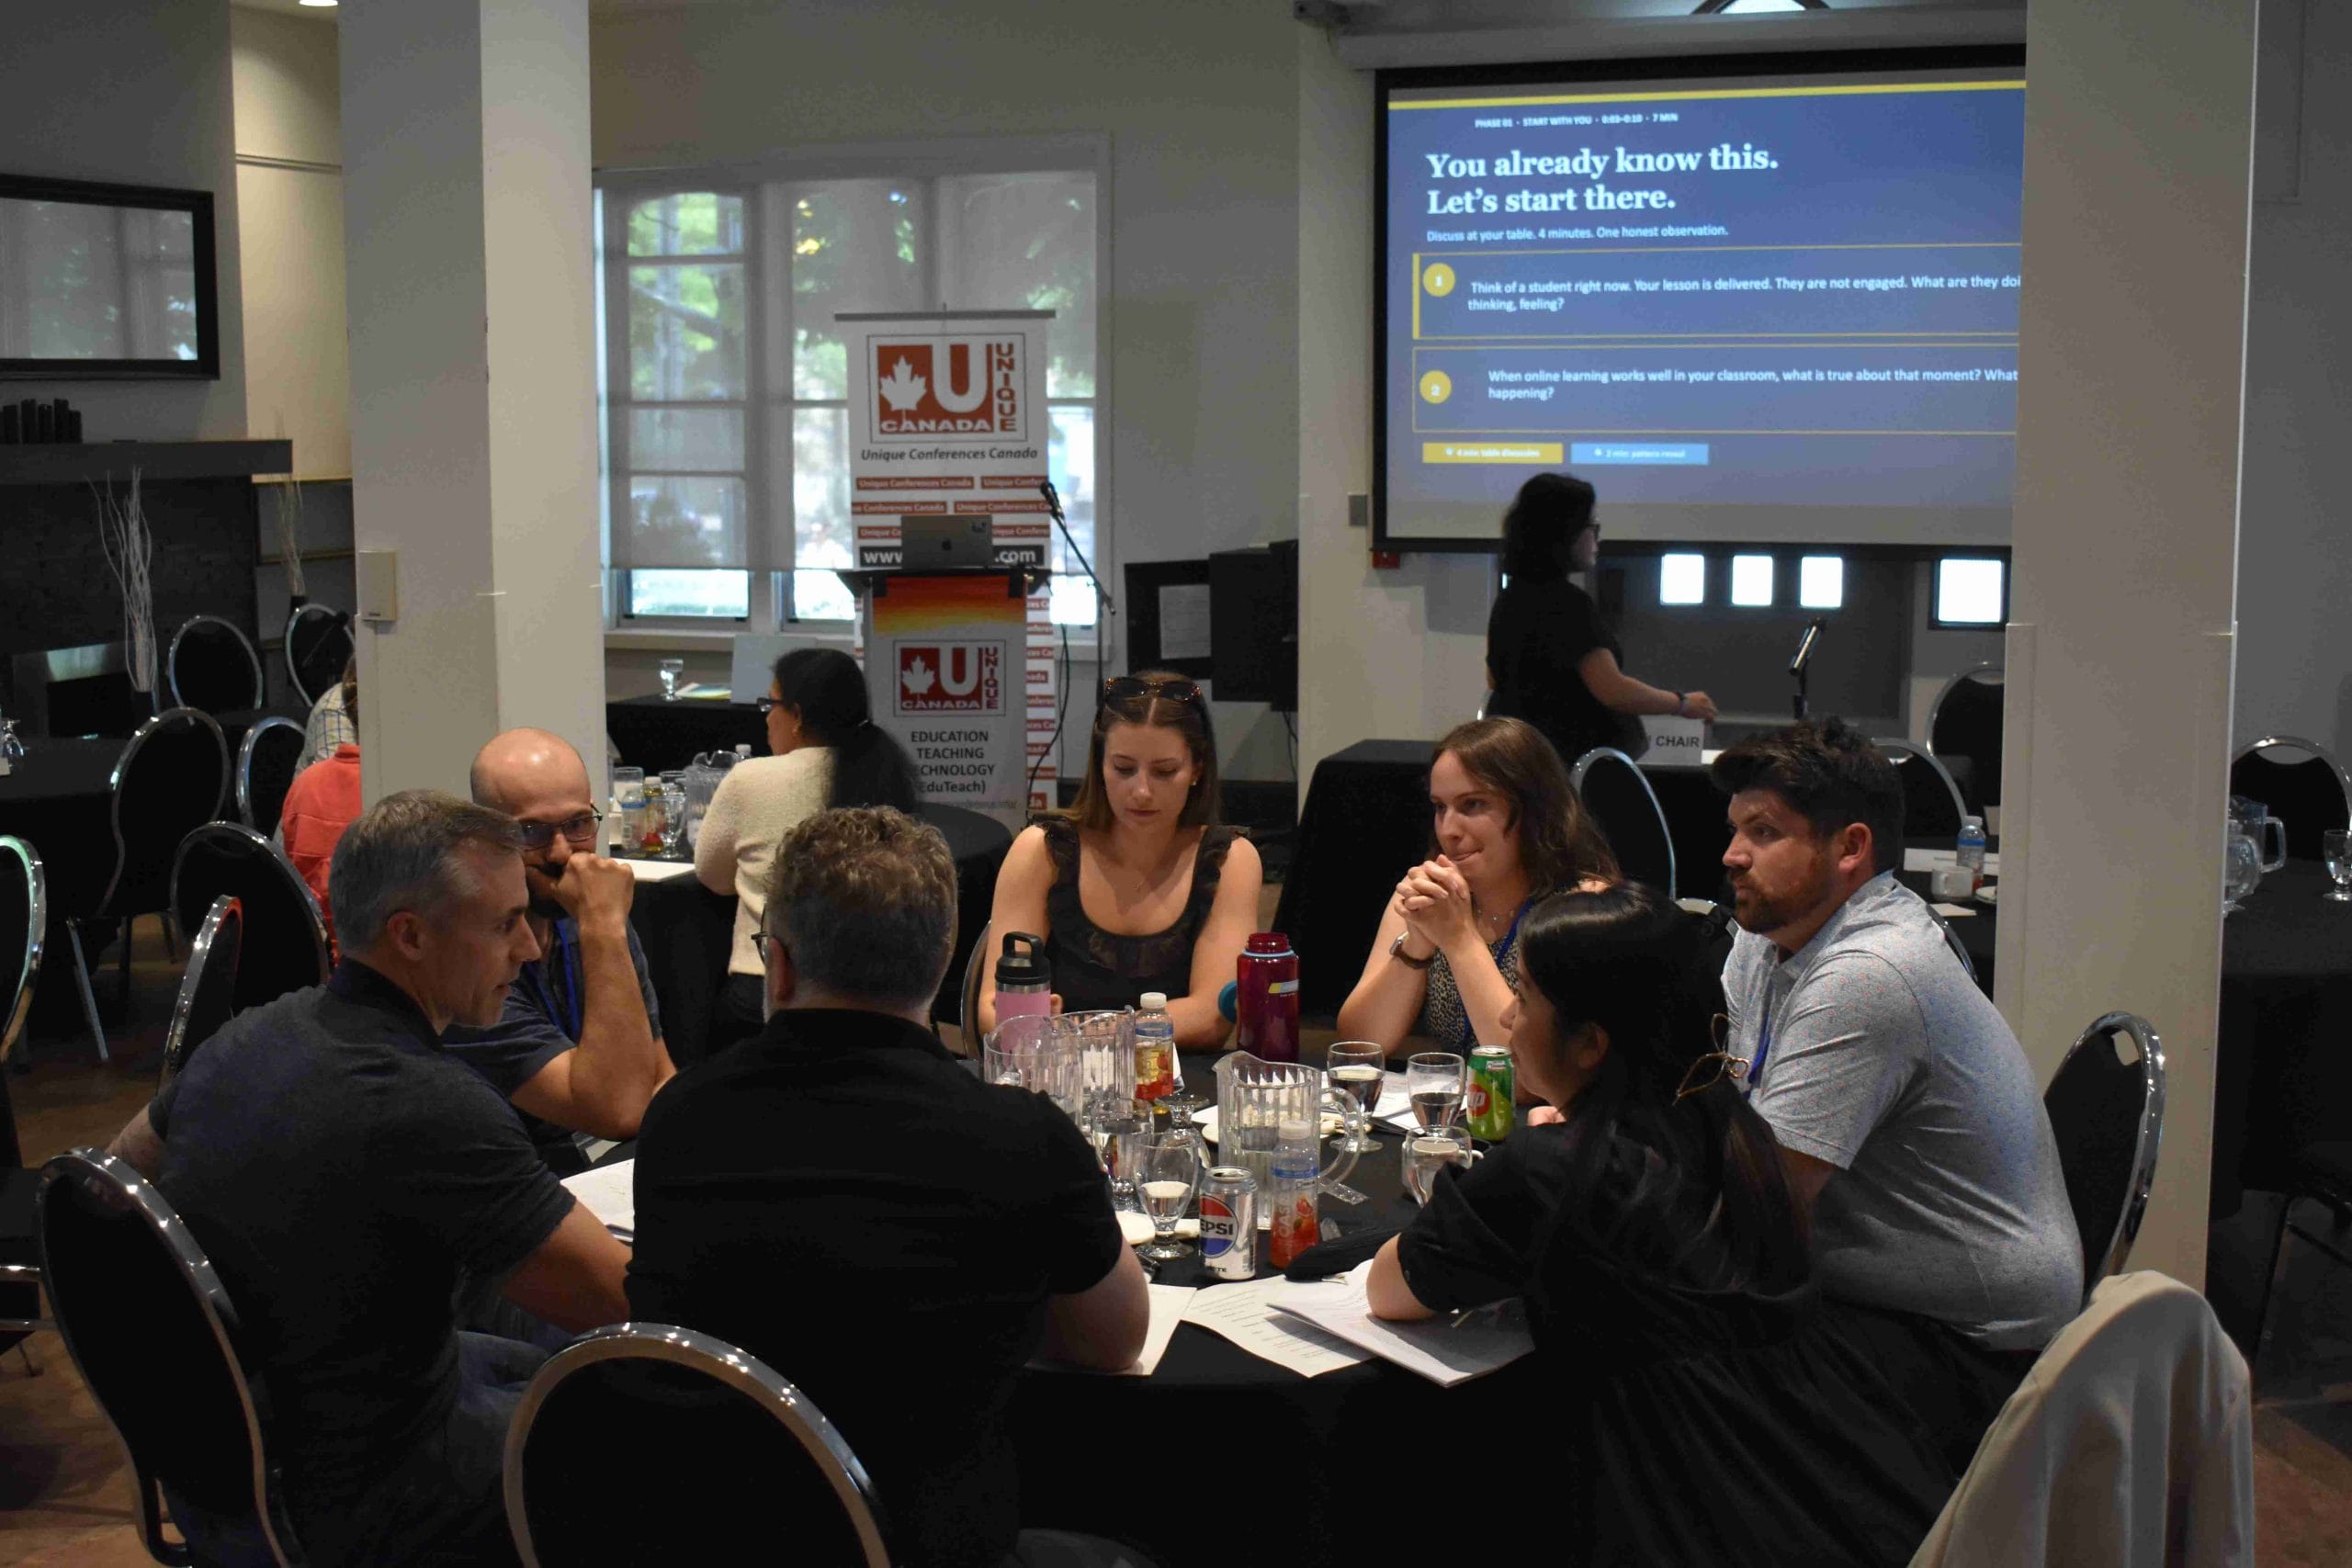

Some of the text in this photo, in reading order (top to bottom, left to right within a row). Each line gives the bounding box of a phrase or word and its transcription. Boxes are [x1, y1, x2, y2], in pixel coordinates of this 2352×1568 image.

[1475, 118, 1501, 129] PHASE
[1522, 117, 1549, 128] START
[1550, 116, 1573, 126] WITH
[1573, 116, 1592, 126] YOU
[1652, 113, 1658, 122] 7
[1659, 113, 1679, 122] MIN
[1425, 142, 1779, 181] You already know this.
[1505, 187, 1577, 213] start
[1584, 184, 1677, 210] there.
[1427, 224, 1729, 243] Discuss at your table. 4 minutes. One honest observation.
[1434, 276, 1442, 287] 1
[1471, 275, 2021, 295] Think of a student right now. Your lesson is delivered. They are not engaged. What are they doi
[1467, 296, 1566, 312] thinking, feeling?
[933, 342, 989, 414] U
[1488, 368, 2018, 384] When online learning works well in your classroom, what is true about that moment? What
[996, 343, 1017, 432] UNIQUE
[1487, 387, 1555, 401] happening?
[880, 419, 992, 432] CANADA
[861, 446, 1038, 463] Unique Conferences Canada
[859, 478, 972, 490] Unique Conferences Canada
[1014, 478, 1046, 487] Confer
[993, 526, 1049, 537] nique Confere
[994, 550, 1036, 563] .com
[939, 646, 979, 696] U
[984, 647, 999, 709] UNIQUE
[901, 700, 980, 709] CANADA
[910, 731, 989, 742] EDUCATION
[1656, 736, 1700, 748] CHAIR
[917, 748, 985, 760] TEACHING
[920, 764, 995, 776] CHNOLOGY
[919, 780, 986, 795] EduTeach)
[1200, 1219, 1234, 1235] EPSI
